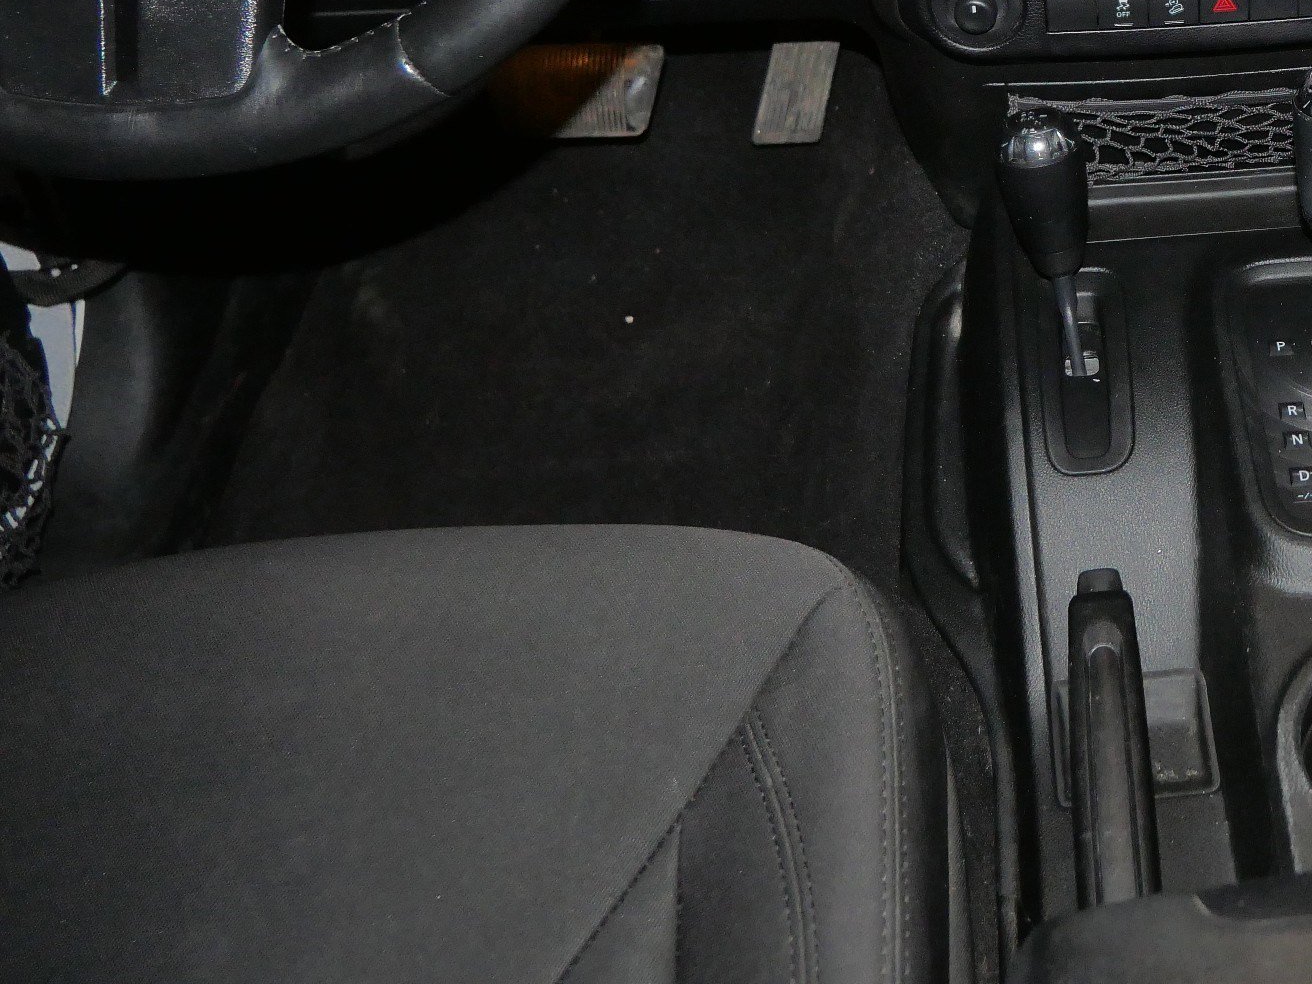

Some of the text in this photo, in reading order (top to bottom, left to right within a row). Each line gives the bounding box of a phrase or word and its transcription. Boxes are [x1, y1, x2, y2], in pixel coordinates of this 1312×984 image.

[1276, 341, 1285, 351] P
[1287, 405, 1298, 416] R
[1292, 434, 1304, 445] N
[1299, 470, 1310, 481] D
